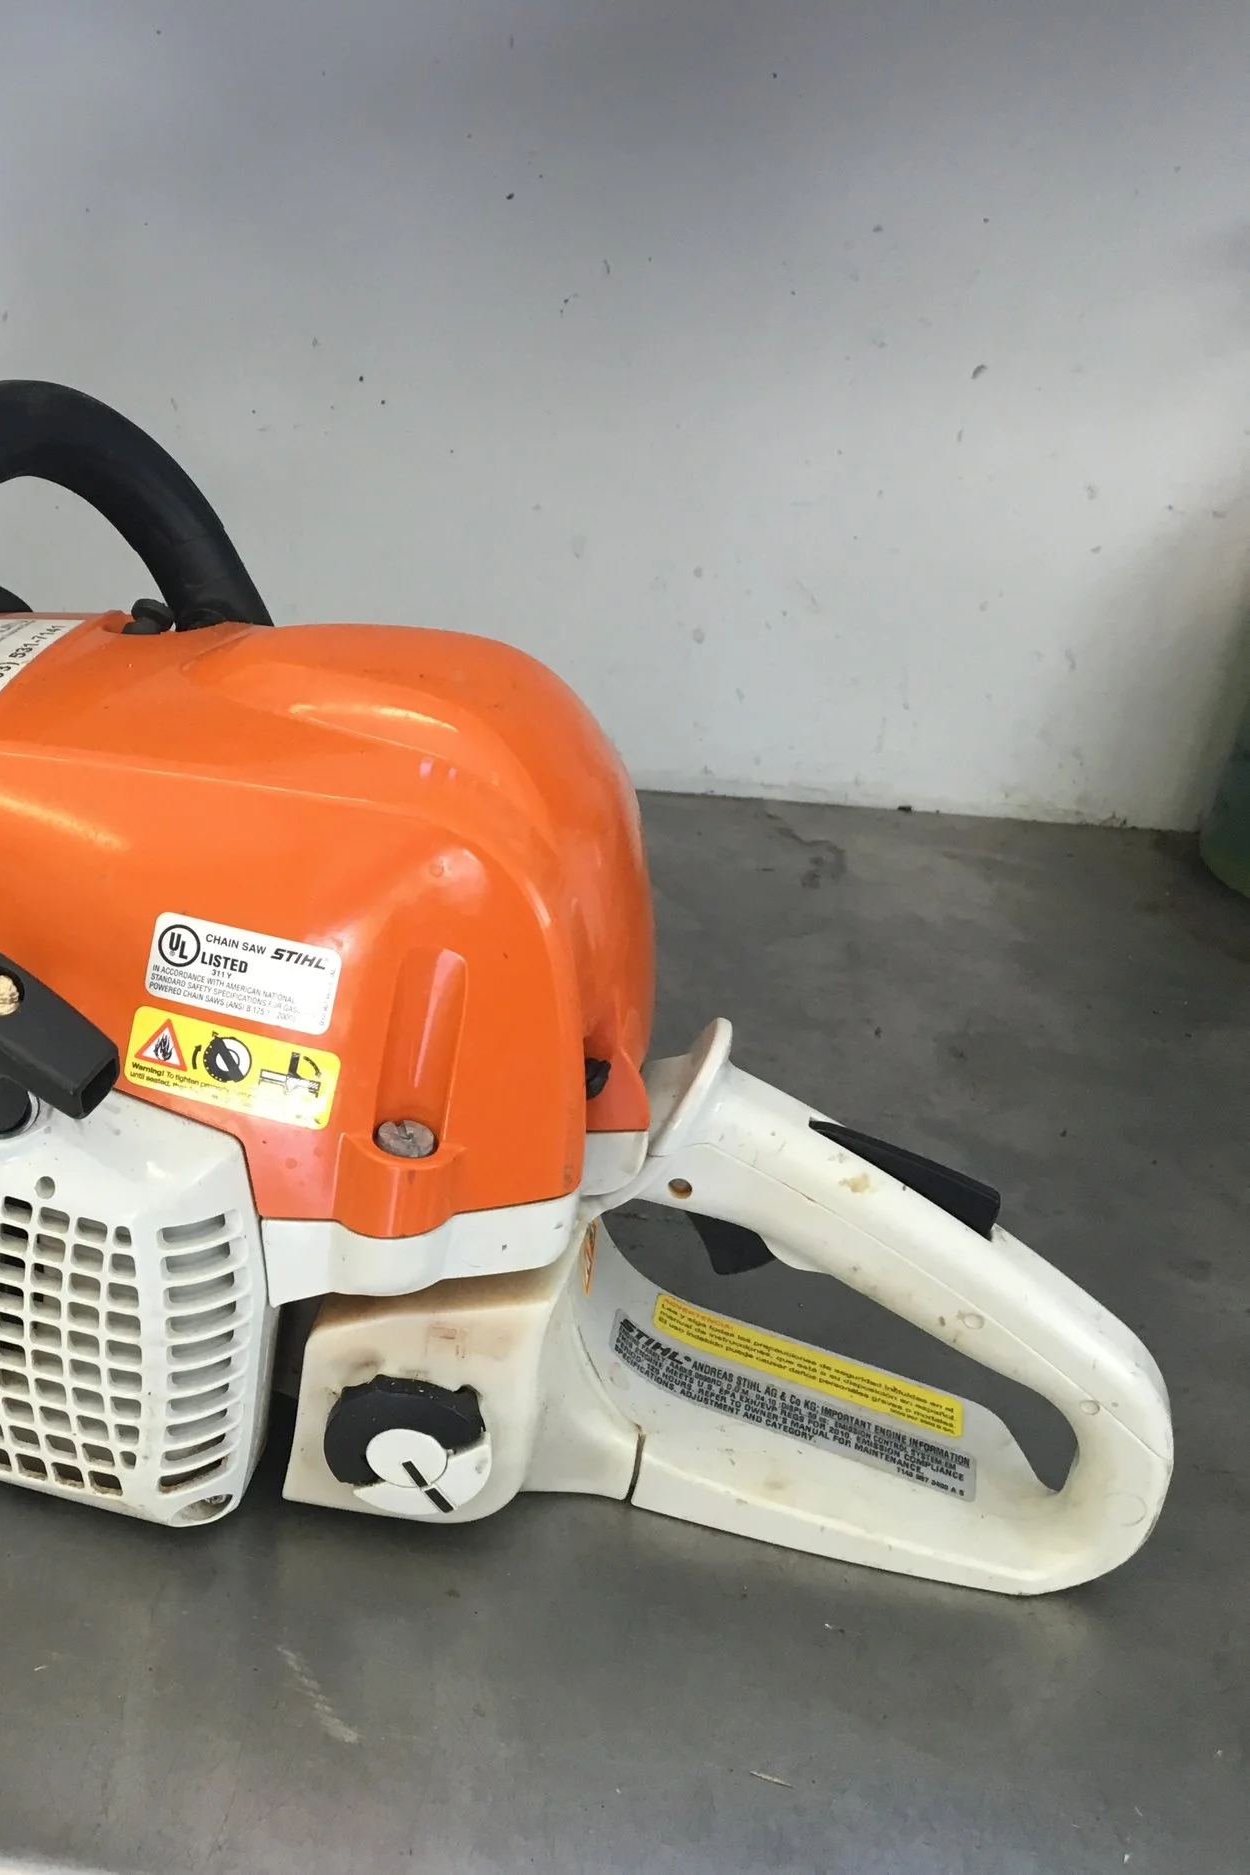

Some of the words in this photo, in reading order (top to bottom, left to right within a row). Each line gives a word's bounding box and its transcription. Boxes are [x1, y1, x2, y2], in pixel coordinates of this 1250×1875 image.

[8, 625, 66, 659] 531-7141
[168, 931, 188, 960] UL
[200, 951, 248, 974] LISTED
[205, 933, 239, 949] CHAIN
[241, 941, 267, 955] SAW
[270, 948, 326, 970] STIHL
[149, 980, 181, 996] POWERED
[182, 988, 204, 1001] CHAIN
[205, 994, 224, 1006] SAWS
[150, 972, 186, 988] STANDARD
[186, 980, 212, 994] SAFETY
[213, 987, 266, 1006] SPECIFICATIONS
[268, 1000, 282, 1010] FR
[152, 964, 160, 972] IN
[160, 965, 205, 983] ACCORDANCE
[207, 976, 224, 987] WITH
[226, 981, 261, 996] AMERICAN
[262, 989, 295, 1004] NATONAL
[130, 1070, 144, 1079] until
[132, 1061, 164, 1076] Warning!
[166, 1070, 174, 1079] To
[175, 1073, 199, 1086] tighten
[620, 1317, 682, 1365] STIHL
[691, 1358, 733, 1384] ANDREAS
[736, 1374, 760, 1393] STIHL
[764, 1385, 776, 1398] AG
[779, 1390, 786, 1401] &
[820, 1405, 871, 1431] IMPORTANT
[874, 1424, 905, 1443] ENGINE
[908, 1436, 969, 1468] INFORMATION
[679, 1387, 740, 1417] ADJUSTMENT
[742, 1410, 762, 1424] AND
[665, 1364, 693, 1384] MEETS
[718, 1385, 735, 1398] EPA
[739, 1394, 777, 1414] EXH/EVP
[780, 1409, 804, 1423] REGS
[807, 1418, 825, 1430] FOR
[856, 1435, 900, 1457] EMISSION
[903, 1452, 964, 1482] COMPLIANCE
[697, 1386, 726, 1403] REFER
[730, 1398, 740, 1409] TO
[790, 1419, 829, 1440] MANUAL
